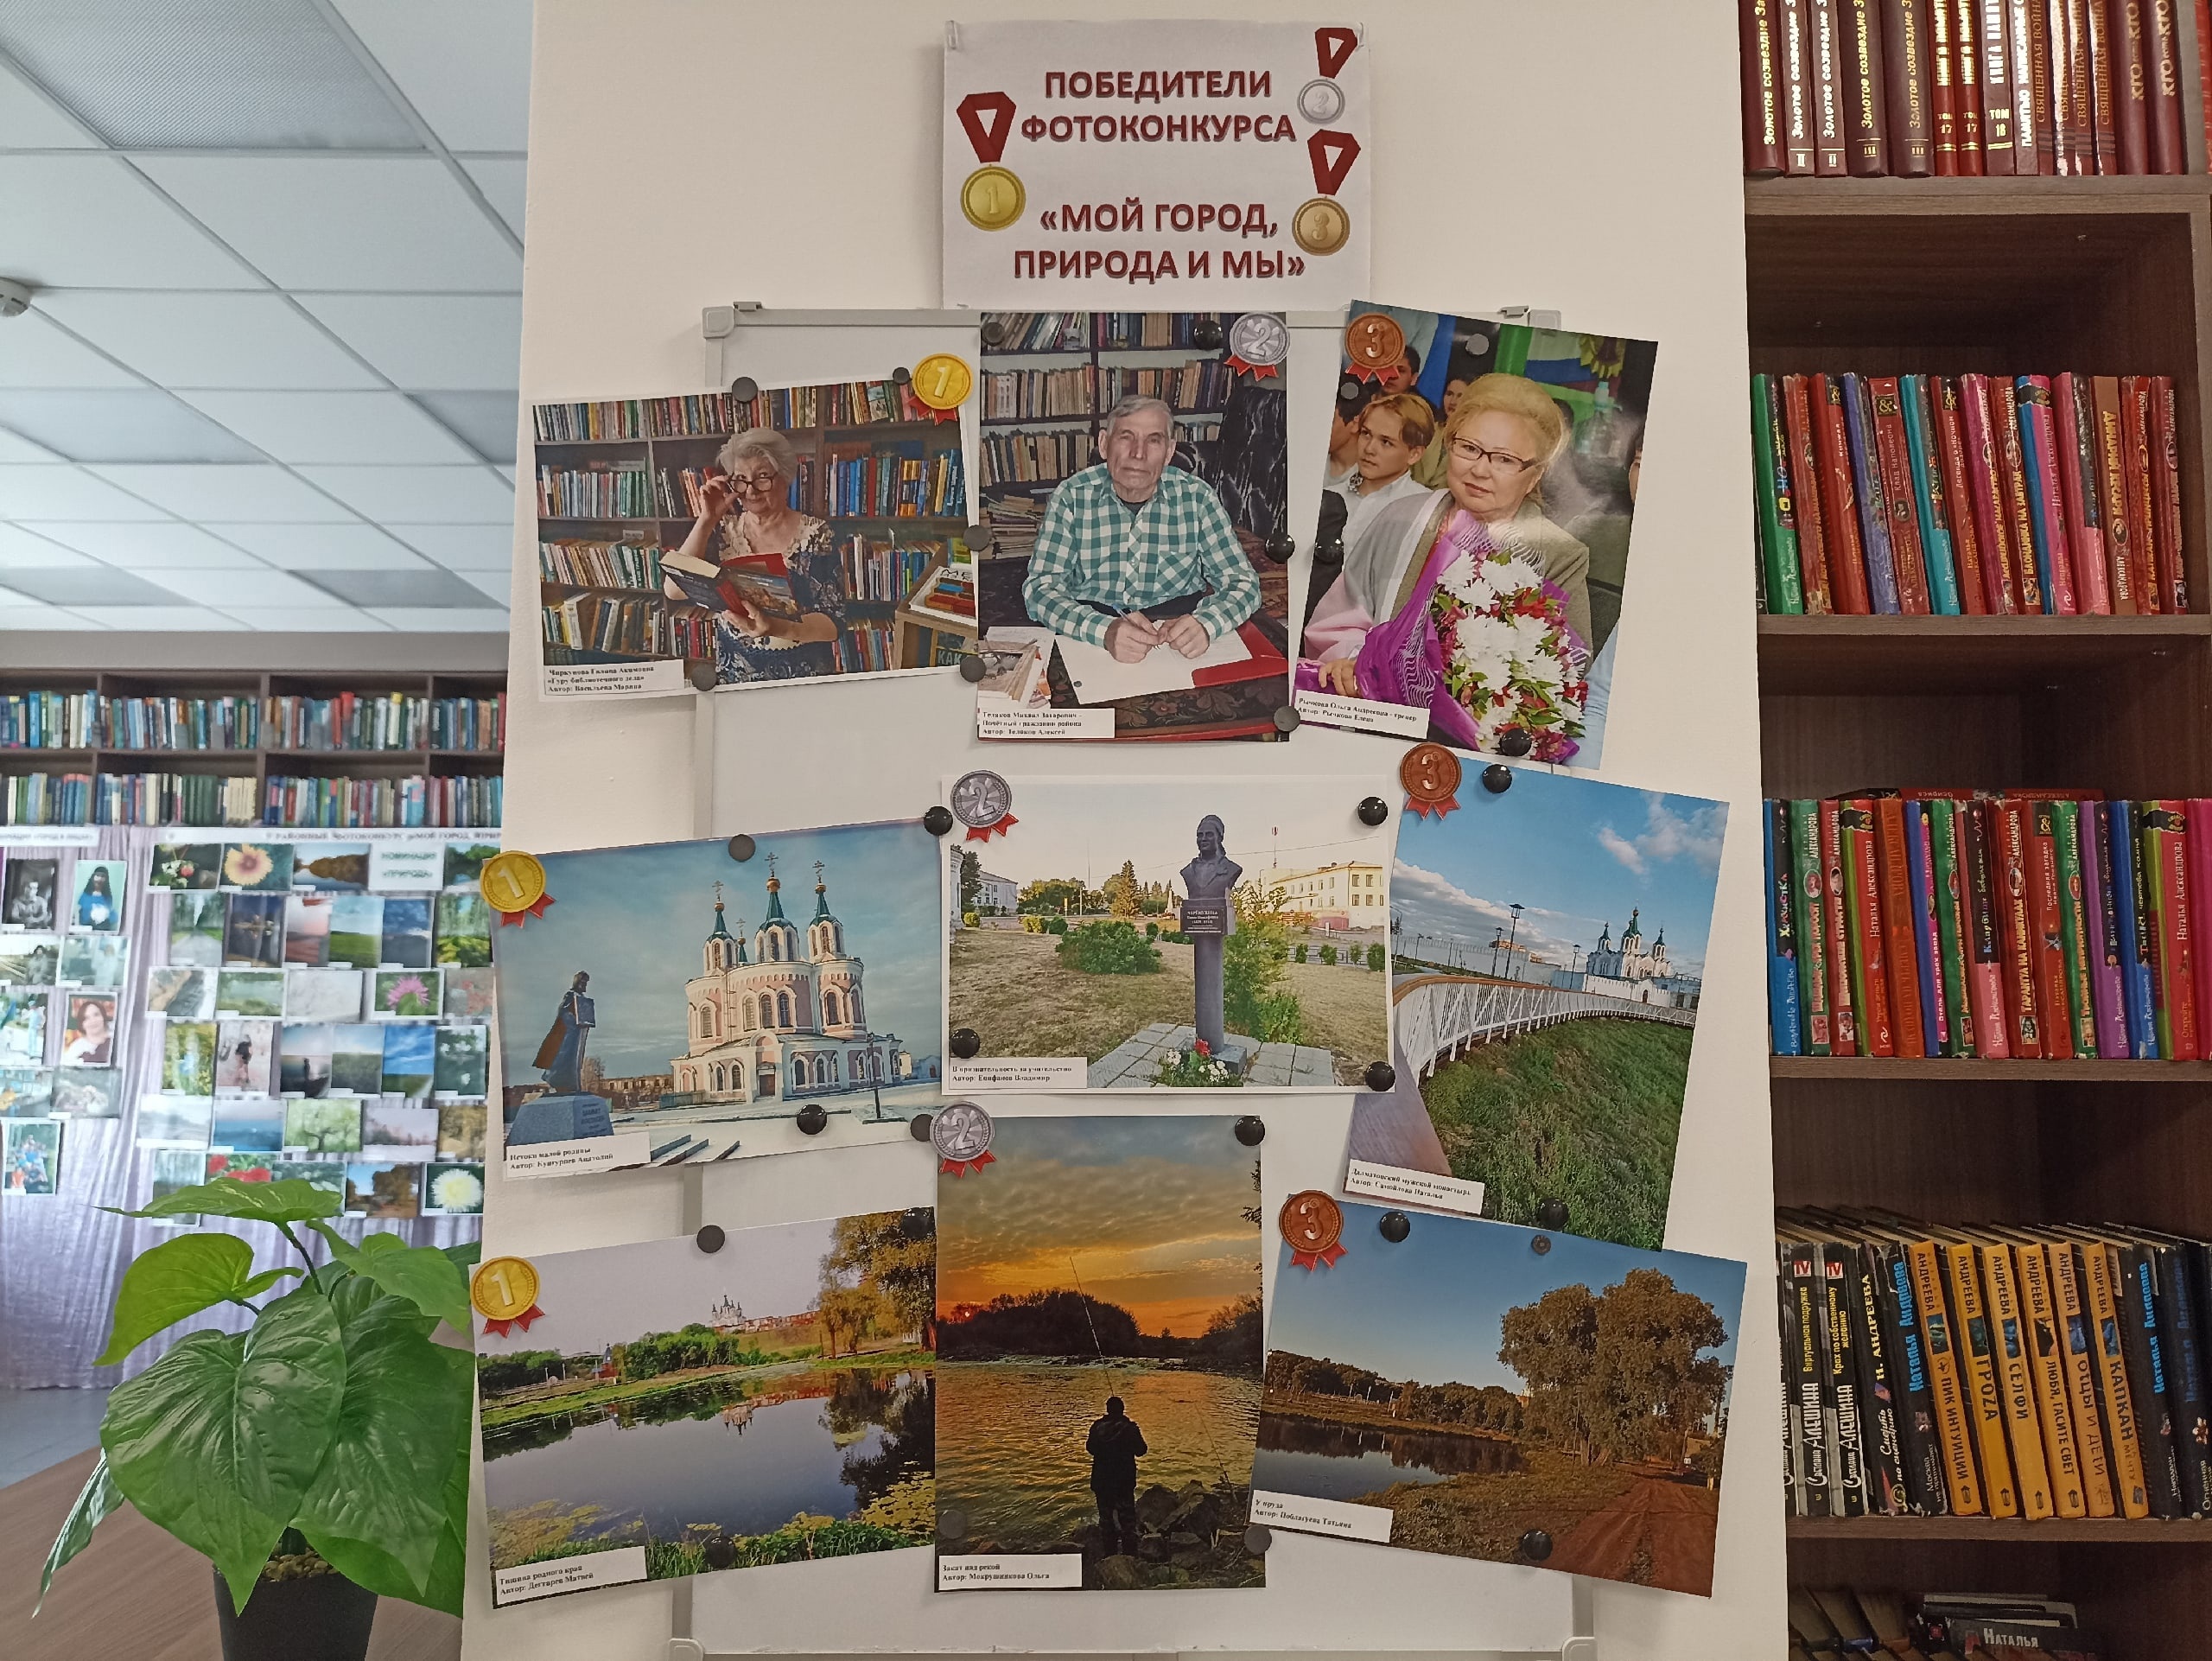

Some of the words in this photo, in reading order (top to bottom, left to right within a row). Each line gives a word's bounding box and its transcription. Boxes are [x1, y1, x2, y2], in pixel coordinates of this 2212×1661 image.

[1758, 19, 1771, 86] созвездие
[1789, 11, 1800, 80] созвездие
[1820, 11, 1830, 80] созвездие
[1856, 11, 1868, 75] созвездие
[1904, 11, 1916, 75] созвездие
[2014, 7, 2029, 84] НАПИСАННЫЕ
[1988, 46, 2004, 85] КНИГА
[2034, 43, 2045, 123] СВЯЩЕННАЯ
[2160, 60, 2176, 97] КТО
[1045, 71, 1271, 104] ПОБЕДИТЕЛИ
[1313, 91, 1329, 115] 2
[1861, 79, 1873, 128] Золотое
[1910, 80, 1920, 128] Золотое
[2075, 47, 2088, 127] СВЯЩЕННАЯ
[2097, 48, 2110, 124] СВЯЩЕННАЯ
[1021, 115, 1296, 143] ФОТОКОНКУРСА
[1763, 92, 1775, 144] Золотое
[1791, 85, 1804, 139] Золотое
[1823, 85, 1835, 138] Золотое
[1940, 124, 1952, 134] 17
[1989, 109, 2009, 119] ТОМ
[1996, 124, 2005, 137] 18
[2019, 90, 2032, 147] ПАМЯТЬЮ
[985, 185, 1000, 214] 1
[1039, 197, 1144, 232] «МОЙ
[1155, 204, 1278, 239] ГОРОД,
[1313, 212, 1331, 241] 3
[1014, 250, 1178, 283] ПРИРОДА
[1188, 250, 1210, 277] И
[1223, 250, 1306, 277] МЫ»
[1248, 322, 1272, 356] 2
[1364, 322, 1382, 358] 3
[931, 364, 950, 398] 1
[1892, 470, 1901, 491] Клад
[1954, 456, 1963, 487] Легенда
[2013, 470, 2025, 506] ЗАВТРАК
[2018, 508, 2027, 520] НА
[2022, 523, 2034, 575] БЛОНДИНКА
[2116, 557, 2128, 601] АЛЕКСАНДРОВА
[1421, 754, 1440, 790] 3
[971, 786, 995, 821] 2
[1807, 812, 1819, 858] АЛЕКСАНДРОВА
[1831, 811, 1840, 856] АЛЕКСАНДРОВА
[2008, 811, 2020, 856] АЛЕКСАНДРОВА
[498, 866, 525, 899] 1
[1865, 840, 1878, 899] Александрова
[2174, 842, 2186, 900] Александрова
[2043, 872, 2052, 911] Последняя
[1868, 902, 1880, 938] Наталья
[2176, 904, 2188, 940] Наталья
[2019, 952, 2028, 965] НА
[2020, 967, 2032, 1012] ТАРАНТУЛ
[956, 1113, 975, 1150] 2
[1300, 1198, 1322, 1240] 3
[491, 1270, 515, 1307] 1
[1917, 1252, 1936, 1311] АНДРЕЕВА
[1958, 1255, 1976, 1314] АНДРЕЕВА
[1993, 1256, 2009, 1315] АНДРЕЕВА
[2026, 1255, 2045, 1314] АНДРЕЕВА
[2058, 1252, 2076, 1311] АНДРЕЕВА
[2094, 1256, 2108, 1314] АНДРЕЕВА
[1799, 1286, 1811, 1324] подружка
[1828, 1286, 1840, 1341] собственному
[1861, 1274, 1884, 1359] АНДРЕЕВА
[1802, 1325, 1815, 1372] Виртуальная
[1833, 1341, 1840, 1352] по
[1839, 1310, 1850, 1348] желанию
[1832, 1353, 1843, 1374] Крах
[1875, 1363, 1885, 1381] Н.
[1904, 1333, 1925, 1392] Наталья
[2045, 1361, 2062, 1400] ЛЮБЯ,
[1941, 1378, 1955, 1404] ПИК
[2008, 1363, 2029, 1420] СЕЛФИ
[2109, 1361, 2133, 1441] КАПКАН
[1885, 1407, 1900, 1465] сценарию
[2052, 1402, 2069, 1444] ГАСИТЕ
[2086, 1415, 2101, 1428] И
[1946, 1408, 1969, 1480] ИНТУИЦИИ
[2061, 1447, 2075, 1475] СВЕТ
[1896, 1467, 1903, 1481] по
[1255, 1509, 1278, 1518] Автор:
[500, 1585, 526, 1595] Автор:
[1984, 1628, 2038, 1648] НАТАЛЬЯ
